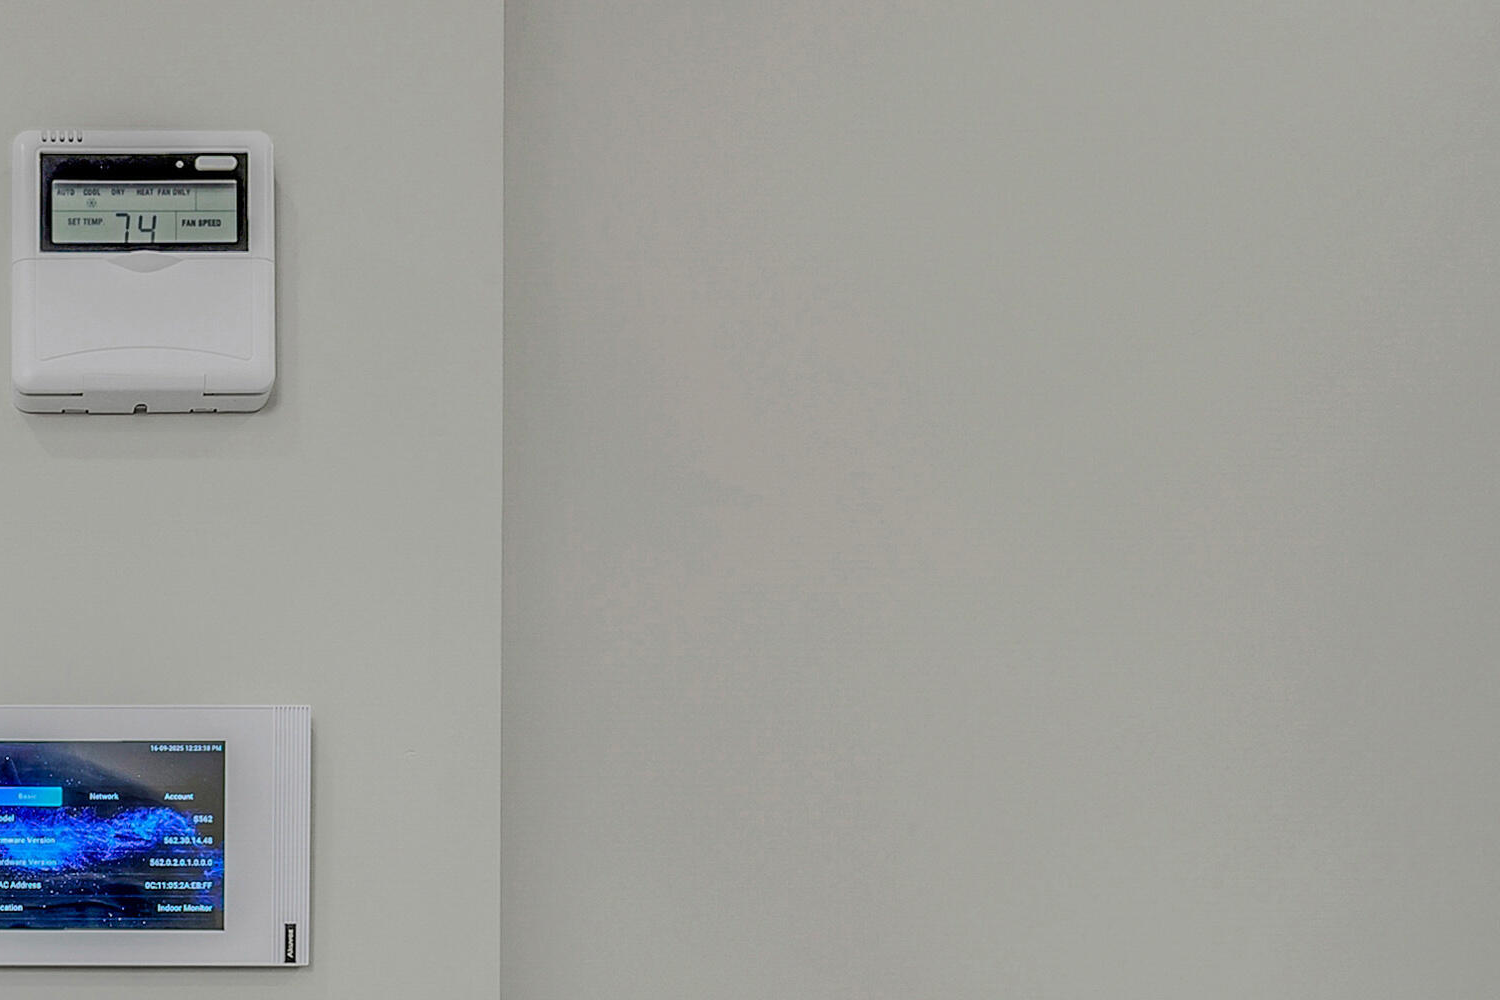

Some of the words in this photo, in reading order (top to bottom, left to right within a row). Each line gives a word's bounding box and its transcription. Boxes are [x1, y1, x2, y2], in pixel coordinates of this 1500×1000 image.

[57, 188, 75, 196] AUTO
[83, 188, 101, 196] COOL
[111, 188, 125, 196] DRY
[136, 188, 154, 196] HEAT
[157, 188, 171, 196] FAN
[173, 188, 191, 196] ONLY
[68, 218, 80, 226] SET
[182, 219, 196, 227] FAN
[199, 219, 221, 227] SPEED
[116, 213, 157, 243] 74
[89, 792, 120, 801] Network
[164, 793, 194, 801] Account
[27, 836, 56, 844] Version
[10, 880, 42, 889] Address
[157, 904, 182, 912] Indoor
[183, 904, 213, 912] Monitor
